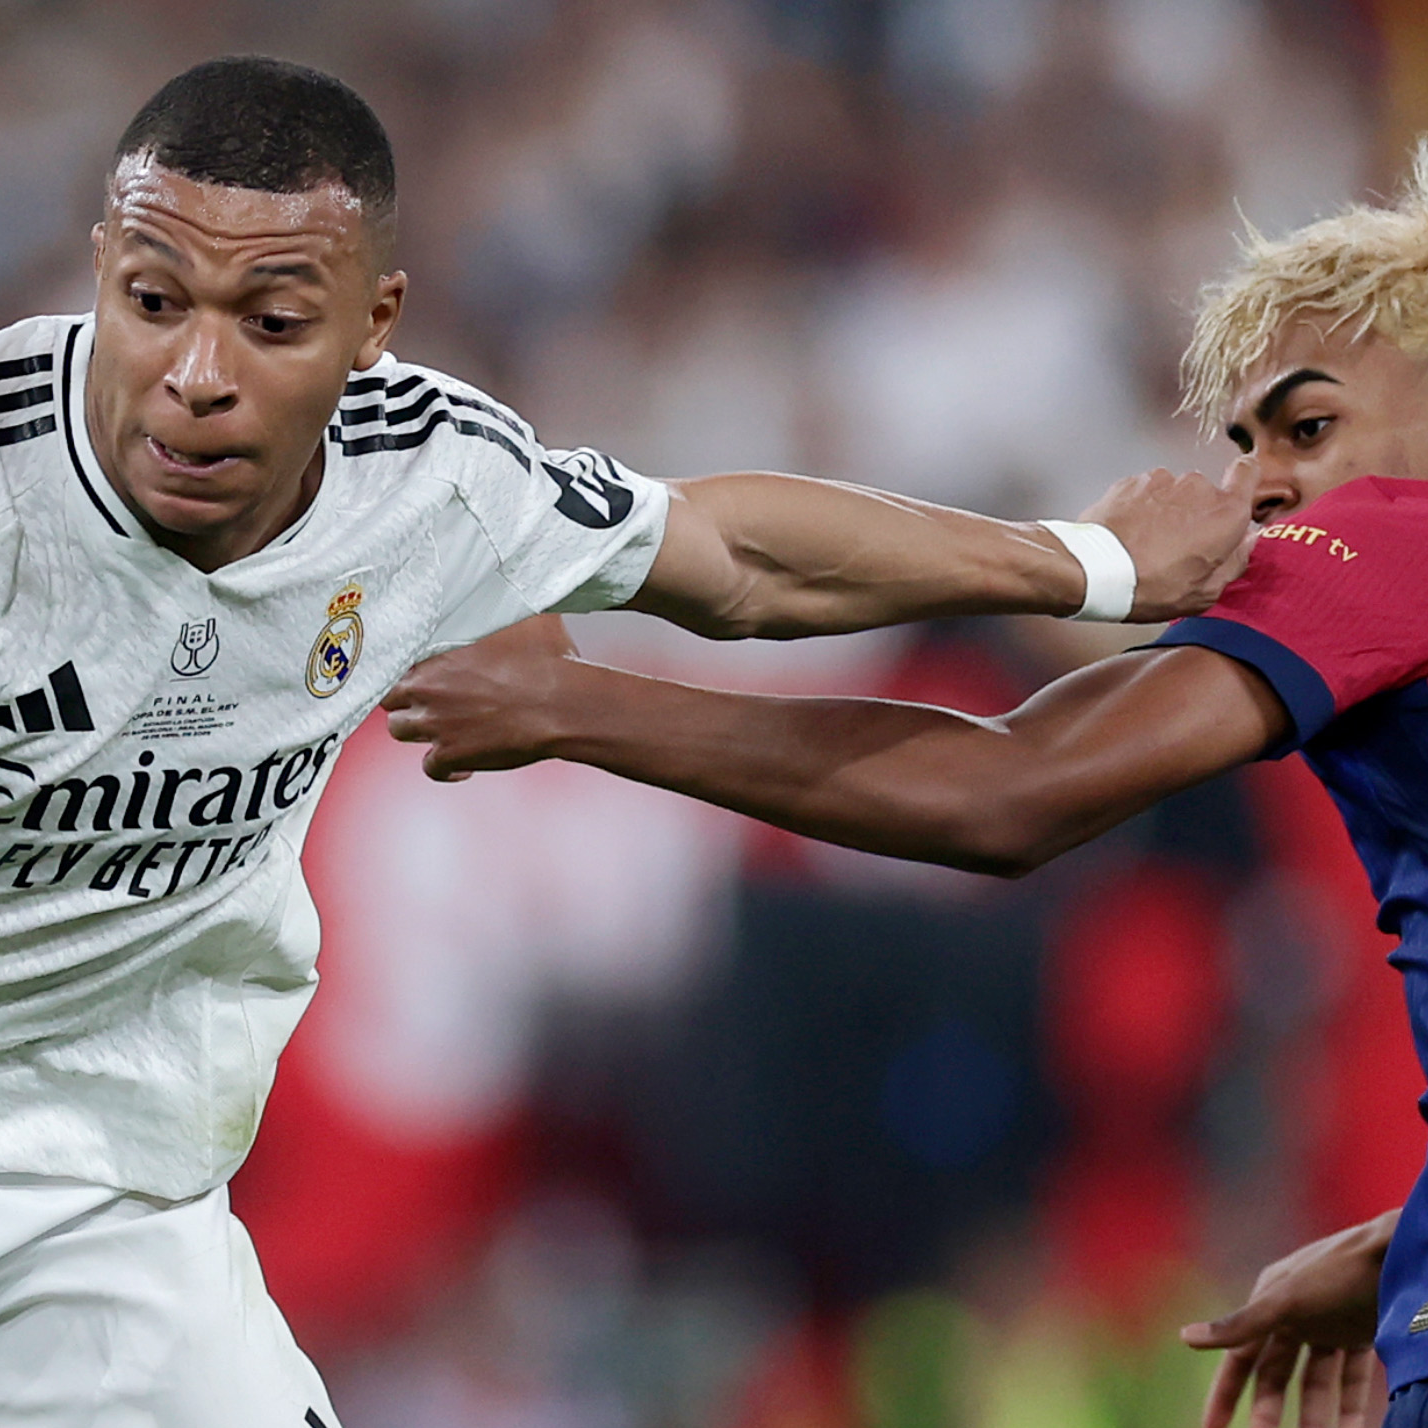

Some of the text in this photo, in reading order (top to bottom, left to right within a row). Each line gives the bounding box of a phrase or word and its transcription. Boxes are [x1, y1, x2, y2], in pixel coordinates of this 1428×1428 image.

[1328, 537, 1359, 562] tv
[153, 693, 216, 707] FINAL
[129, 711, 154, 723] OPA
[156, 708, 173, 718] DE
[200, 705, 215, 714] EL
[216, 701, 240, 712] REY
